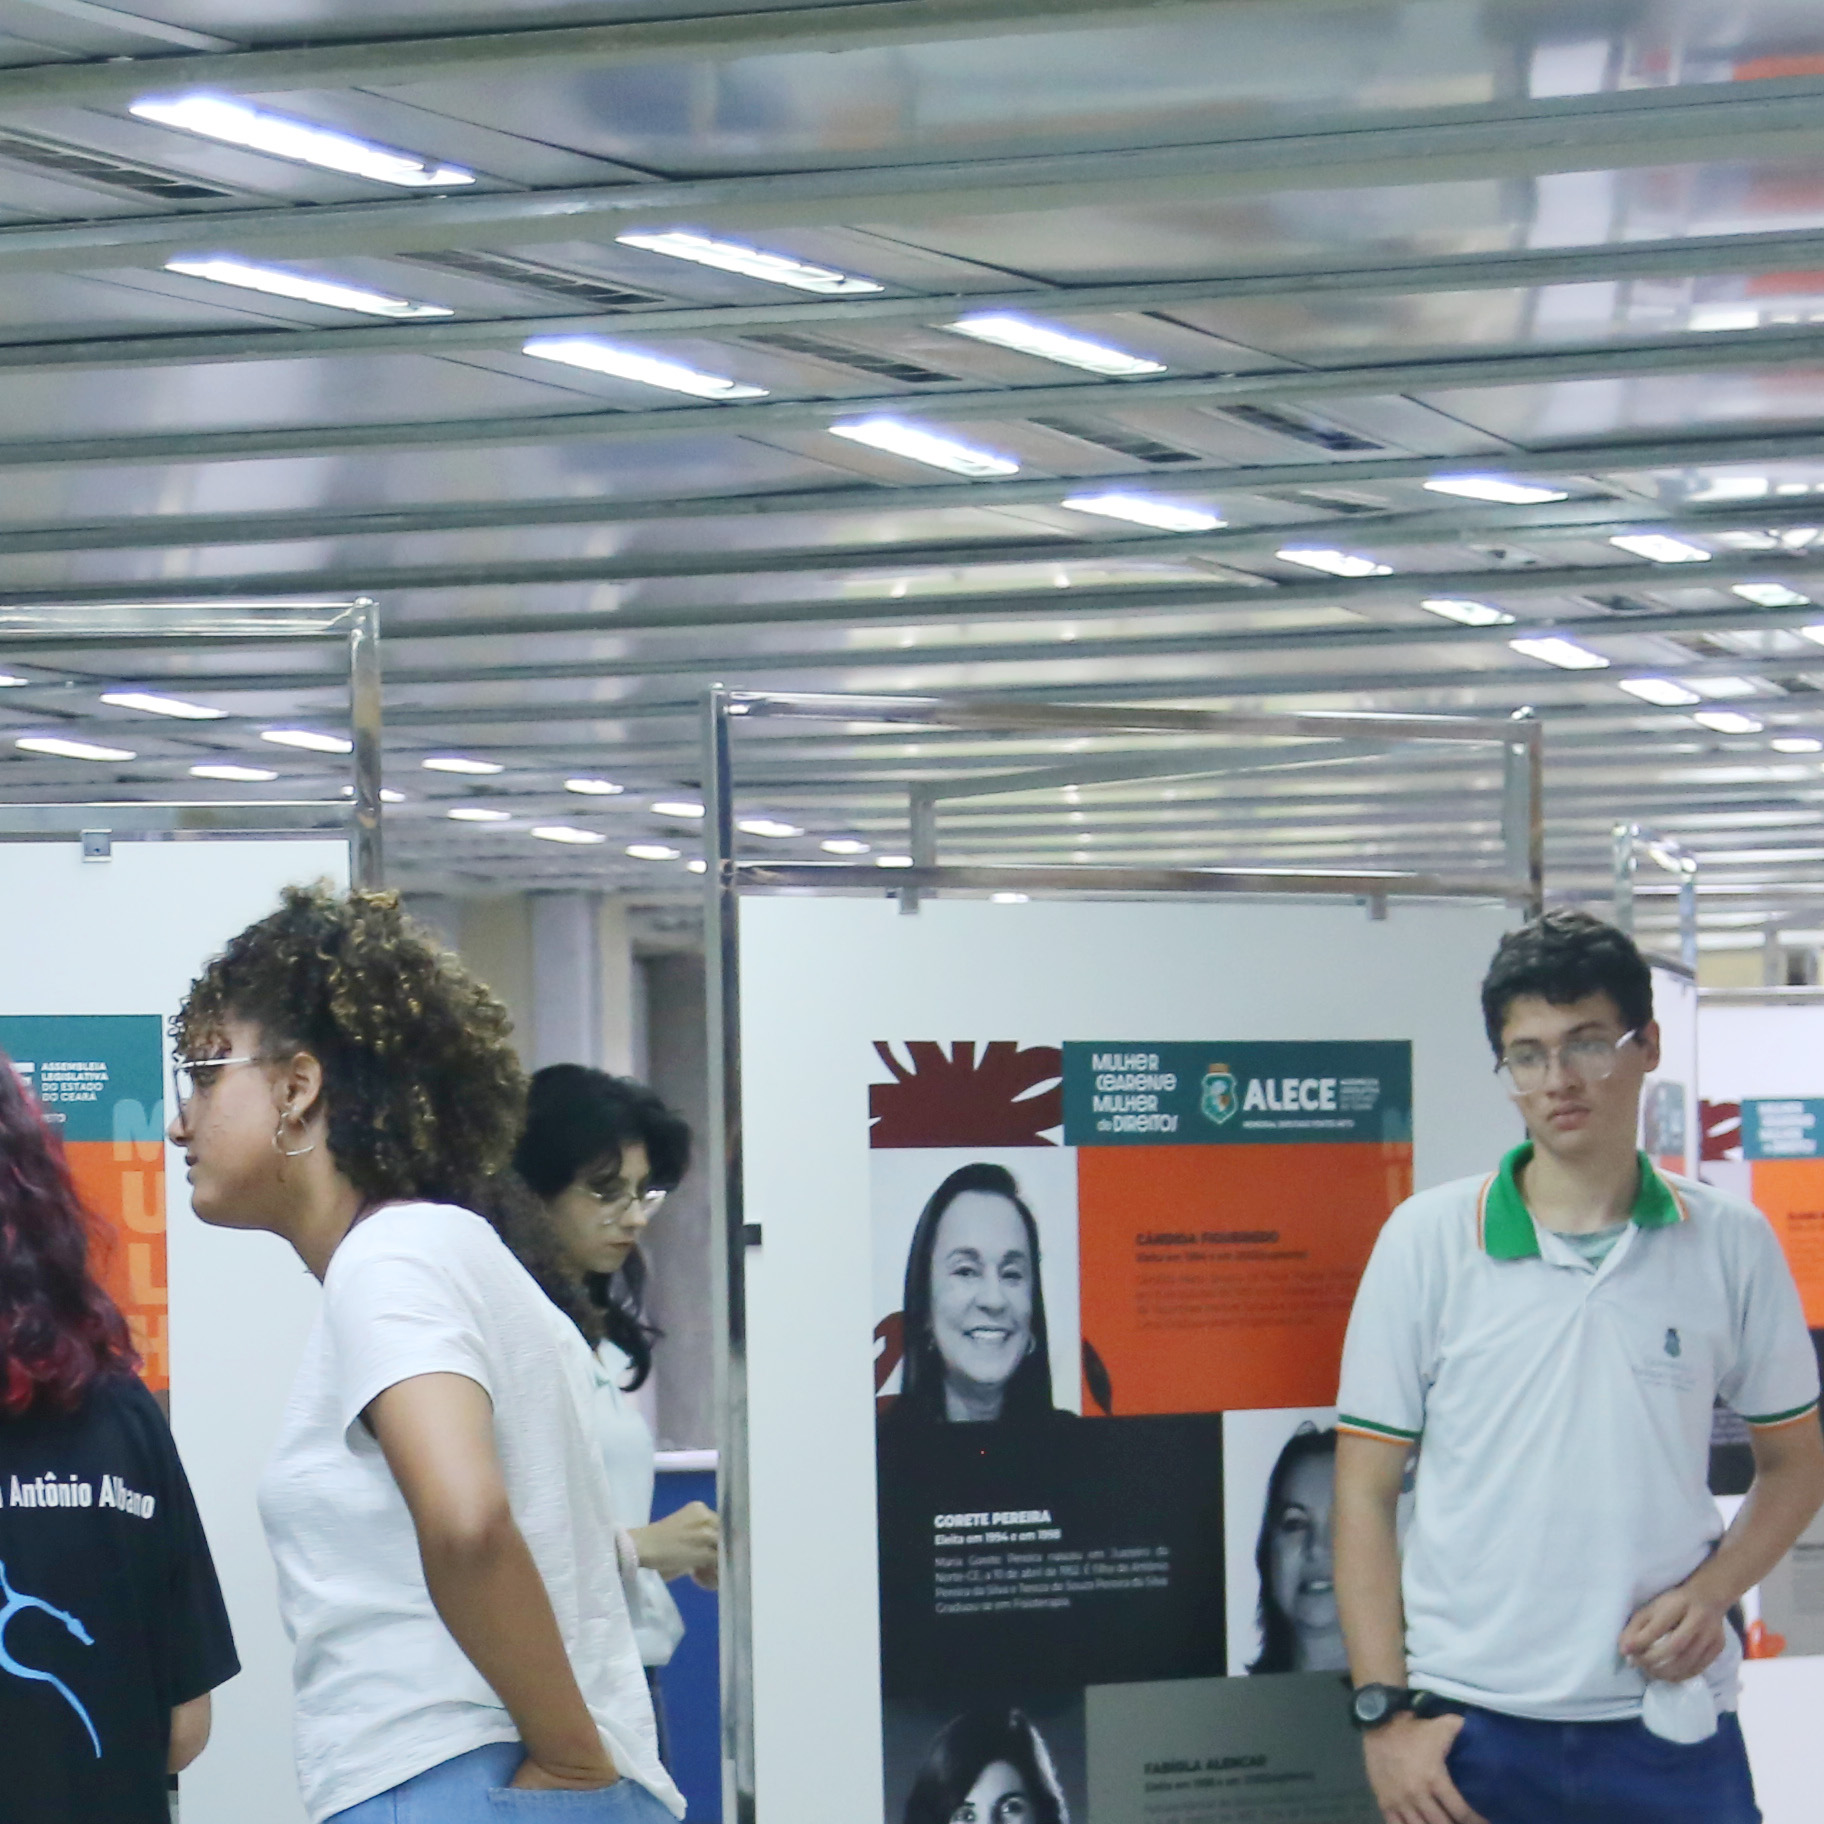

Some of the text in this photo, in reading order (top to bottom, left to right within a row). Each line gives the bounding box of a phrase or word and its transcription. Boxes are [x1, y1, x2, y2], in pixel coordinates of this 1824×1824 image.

[41, 1062, 108, 1071] ASSEMBLEIA
[41, 1072, 109, 1081] LEGISLATIVA
[42, 1082, 104, 1091] DO ESTADO
[42, 1092, 58, 1101] DO
[1242, 1078, 1337, 1111] ALECE
[10, 1471, 92, 1507] Antônio
[99, 1474, 155, 1520] Albano
[991, 1510, 1052, 1526] PEREIRA
